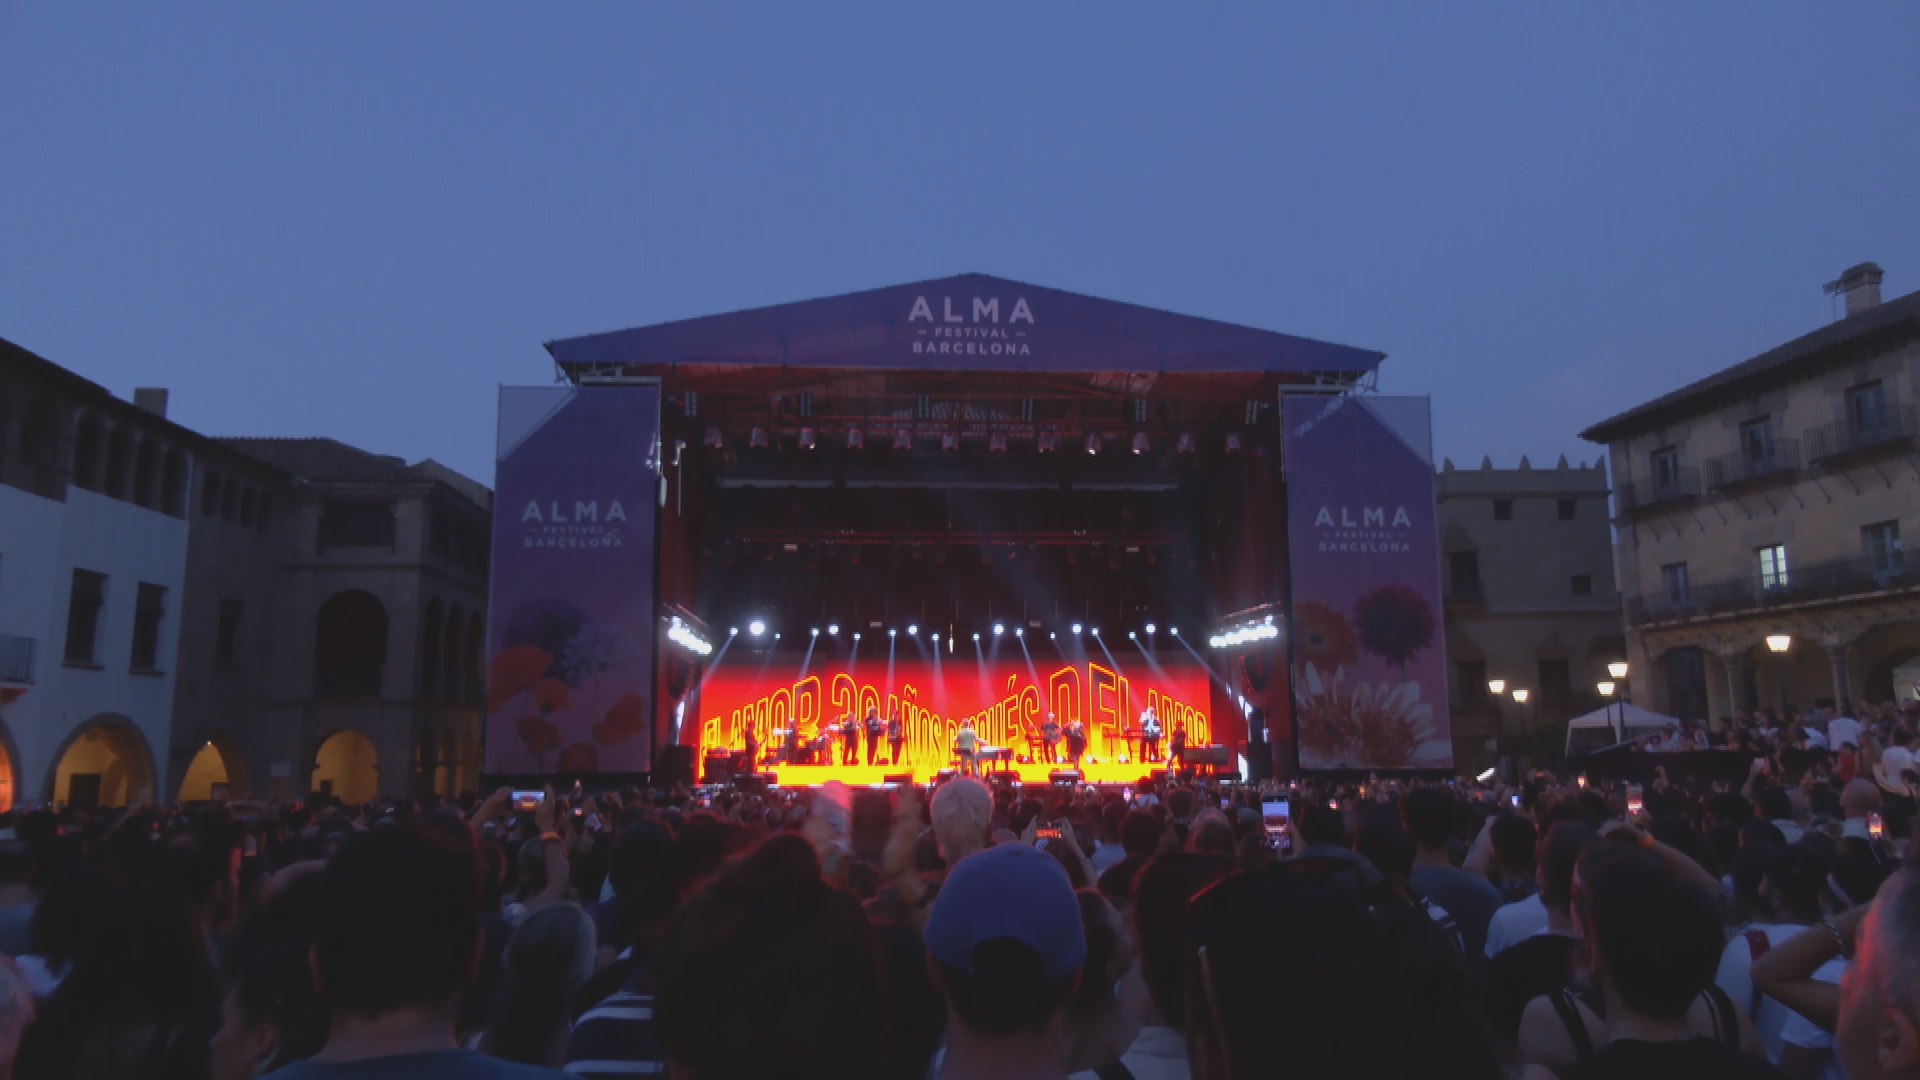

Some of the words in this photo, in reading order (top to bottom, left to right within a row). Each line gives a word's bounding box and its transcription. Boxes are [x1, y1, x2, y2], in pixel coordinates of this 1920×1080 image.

[908, 295, 1035, 324] ALMA
[935, 327, 1009, 339] FESTIVAL
[912, 341, 1031, 356] BARCELONA
[521, 499, 627, 523] ALMA
[1314, 505, 1412, 528] ALMA
[1334, 530, 1393, 539] FESTIVAL
[523, 537, 624, 549] BARCELONA
[1318, 541, 1411, 553] BARCELONA
